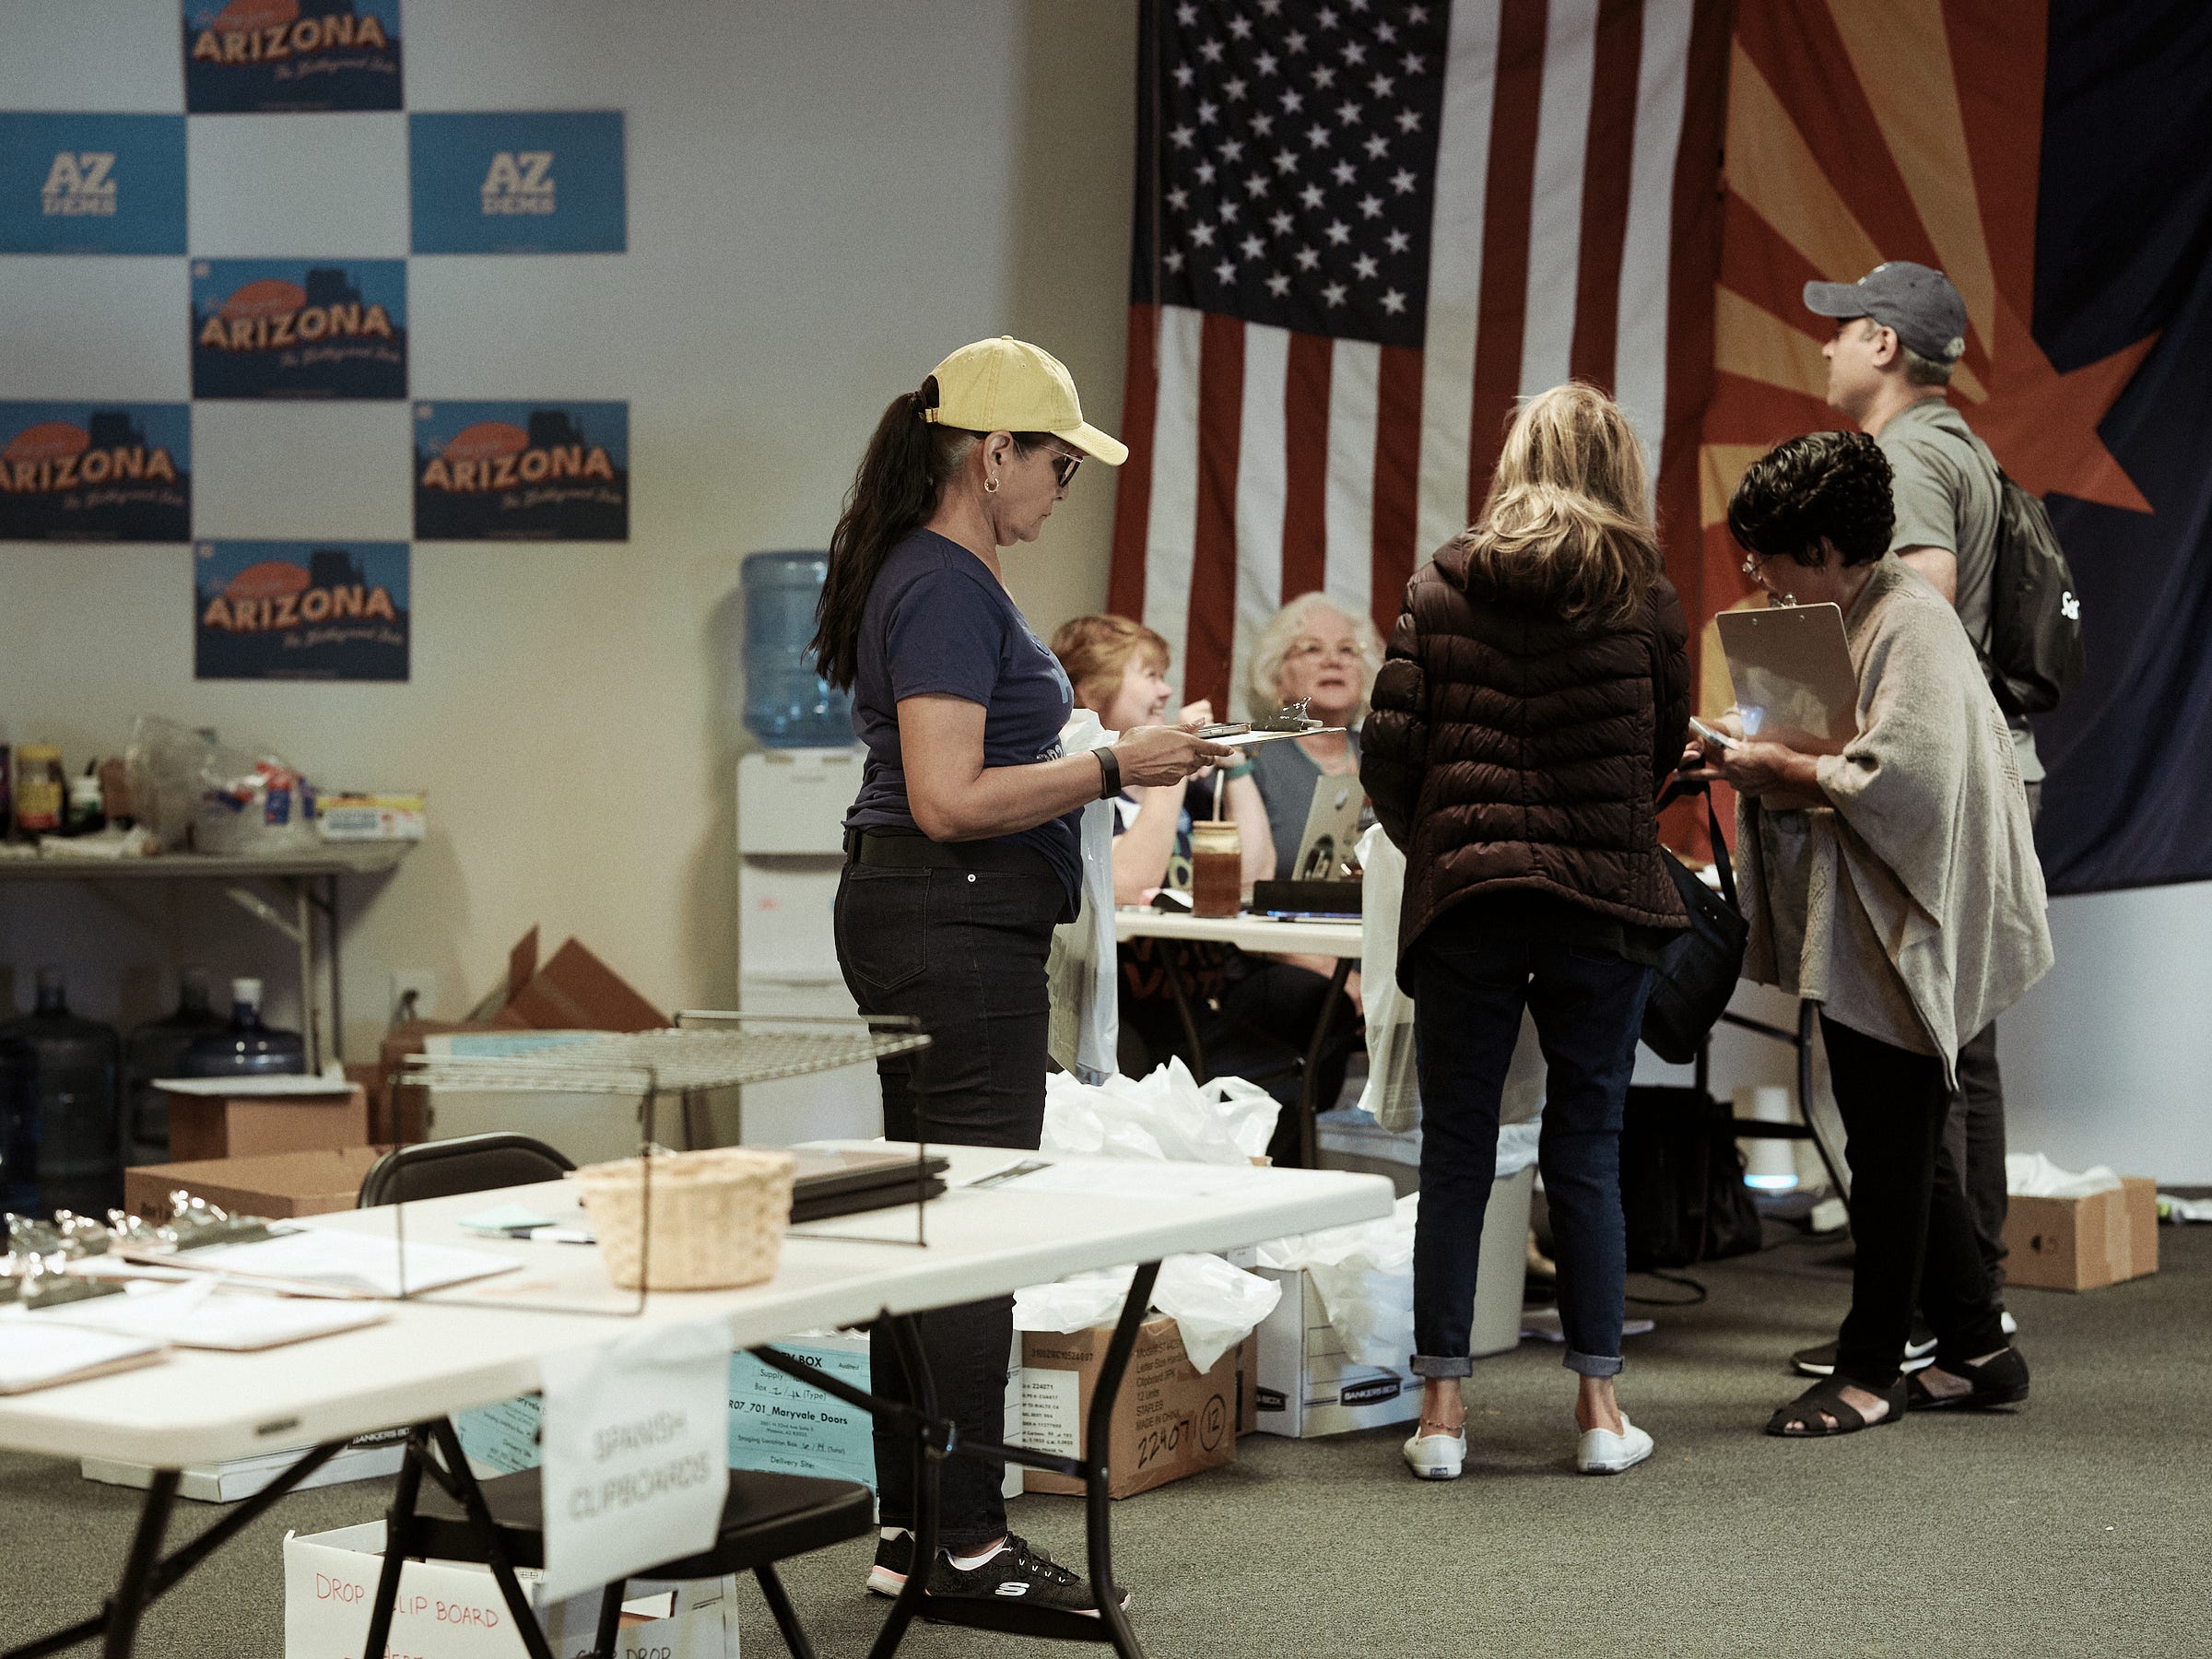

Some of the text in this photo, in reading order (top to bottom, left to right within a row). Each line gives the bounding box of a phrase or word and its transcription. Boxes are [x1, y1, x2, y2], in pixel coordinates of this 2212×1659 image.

[192, 14, 387, 65] ARIZONA
[41, 152, 116, 193] AZ
[481, 151, 556, 193] AZ
[199, 301, 394, 352] ARIZONA
[422, 445, 616, 494] ARIZONA
[203, 583, 397, 634] ARIZONA
[760, 1369, 783, 1381] Supply
[799, 1353, 822, 1368] BOX
[754, 1382, 767, 1392] Box
[1136, 1401, 1163, 1417] STAPLES
[771, 1455, 798, 1467] Delivery
[316, 1572, 500, 1628] DROP LIP BOARD
